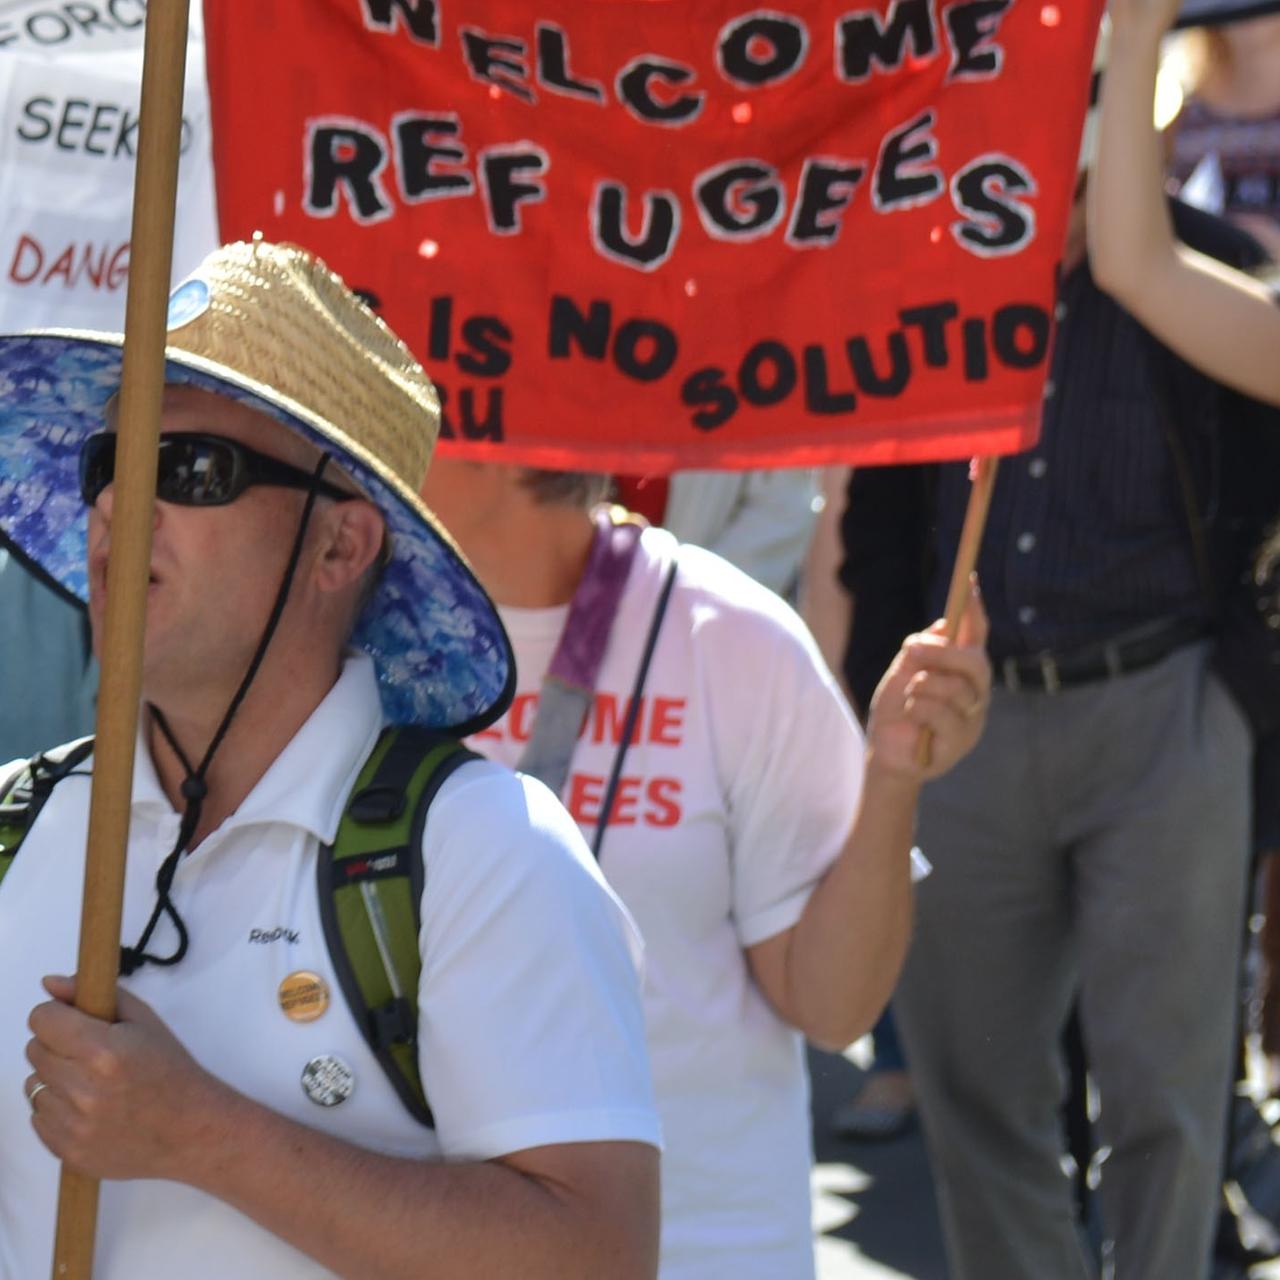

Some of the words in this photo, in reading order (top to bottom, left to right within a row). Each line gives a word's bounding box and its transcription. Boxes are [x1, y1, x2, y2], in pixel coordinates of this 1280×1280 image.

[17, 96, 192, 159] SEEK
[302, 110, 1038, 271] REFUGEES
[8, 233, 132, 293] DANG
[548, 294, 679, 384] NO
[681, 302, 1050, 432] SOLUTIO
